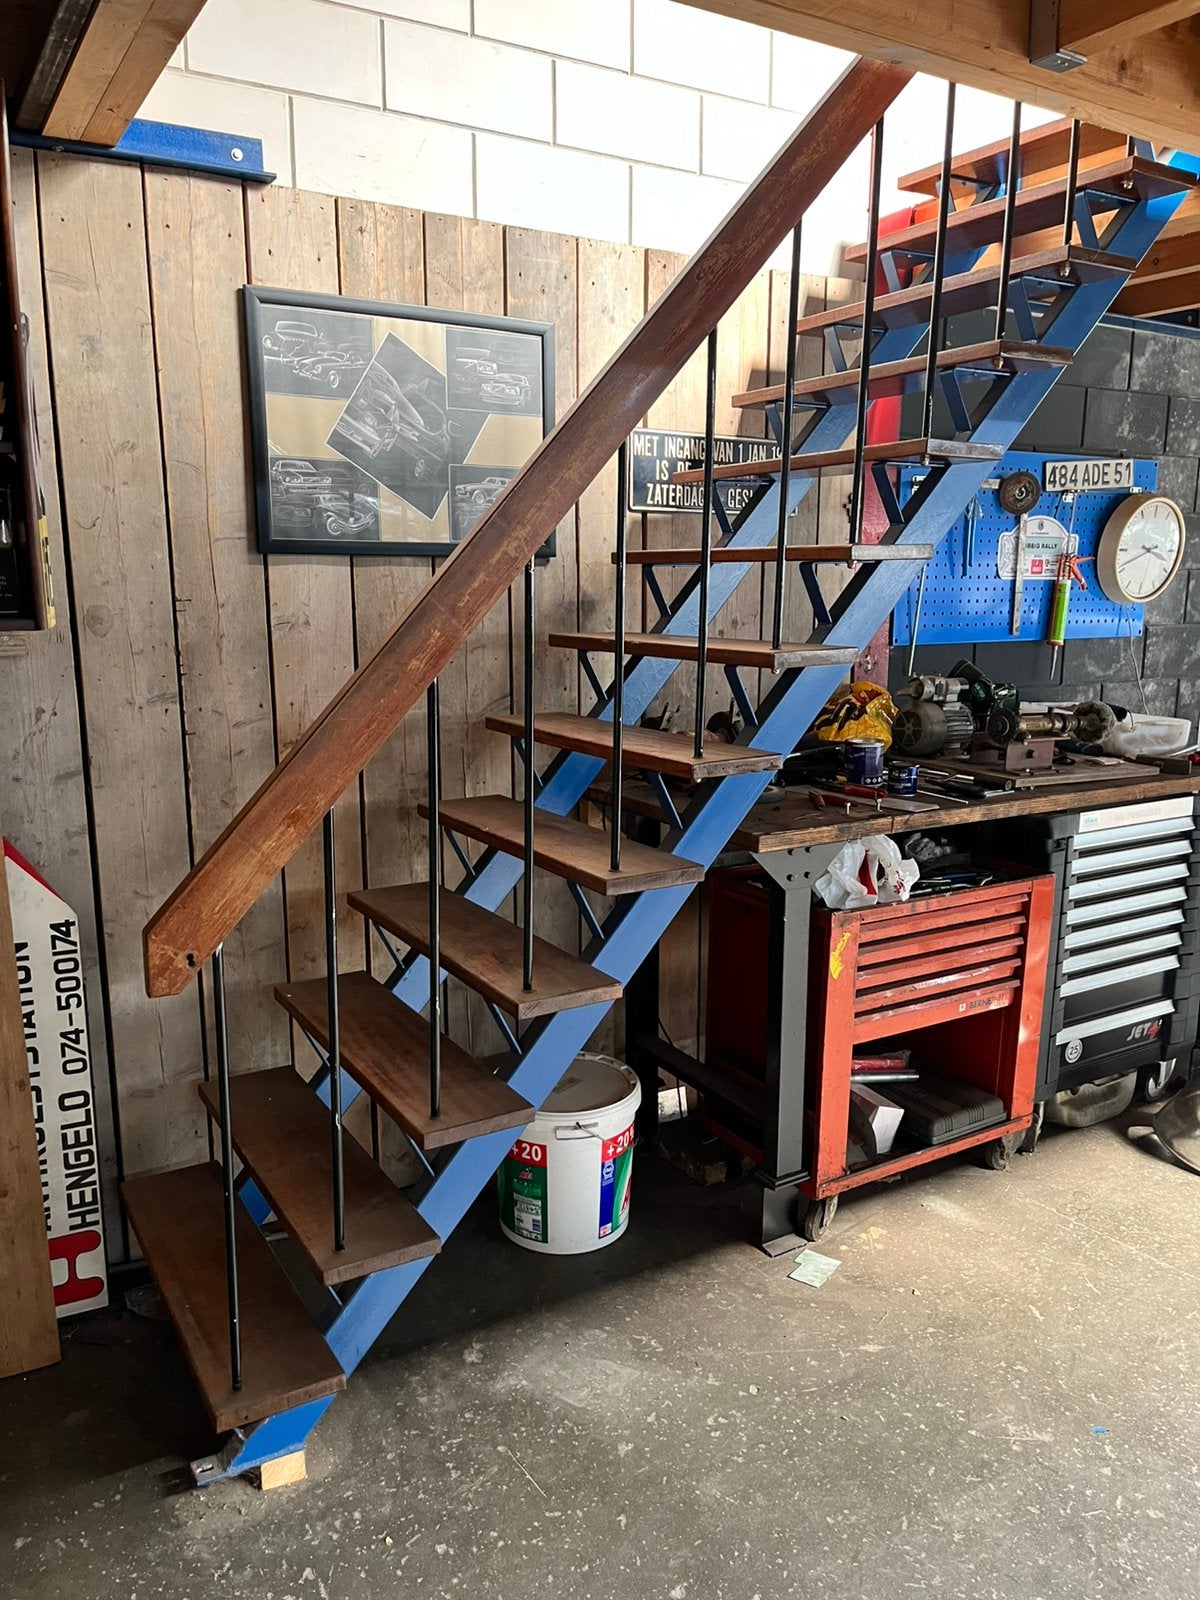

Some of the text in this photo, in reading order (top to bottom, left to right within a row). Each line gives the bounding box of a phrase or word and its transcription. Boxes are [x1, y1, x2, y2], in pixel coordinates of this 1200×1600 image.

[633, 433, 659, 456] MET
[664, 435, 706, 461] INGANG
[712, 439, 734, 463] VAN
[738, 443, 743, 463] 1
[747, 444, 767, 463] JAN
[655, 459, 670, 481] IS
[1047, 461, 1131, 488] 484 ADE 51
[646, 482, 705, 508] ZATERDAG
[1069, 1044, 1079, 1056] 25
[49, 919, 100, 1231] HENGELO 074-500174
